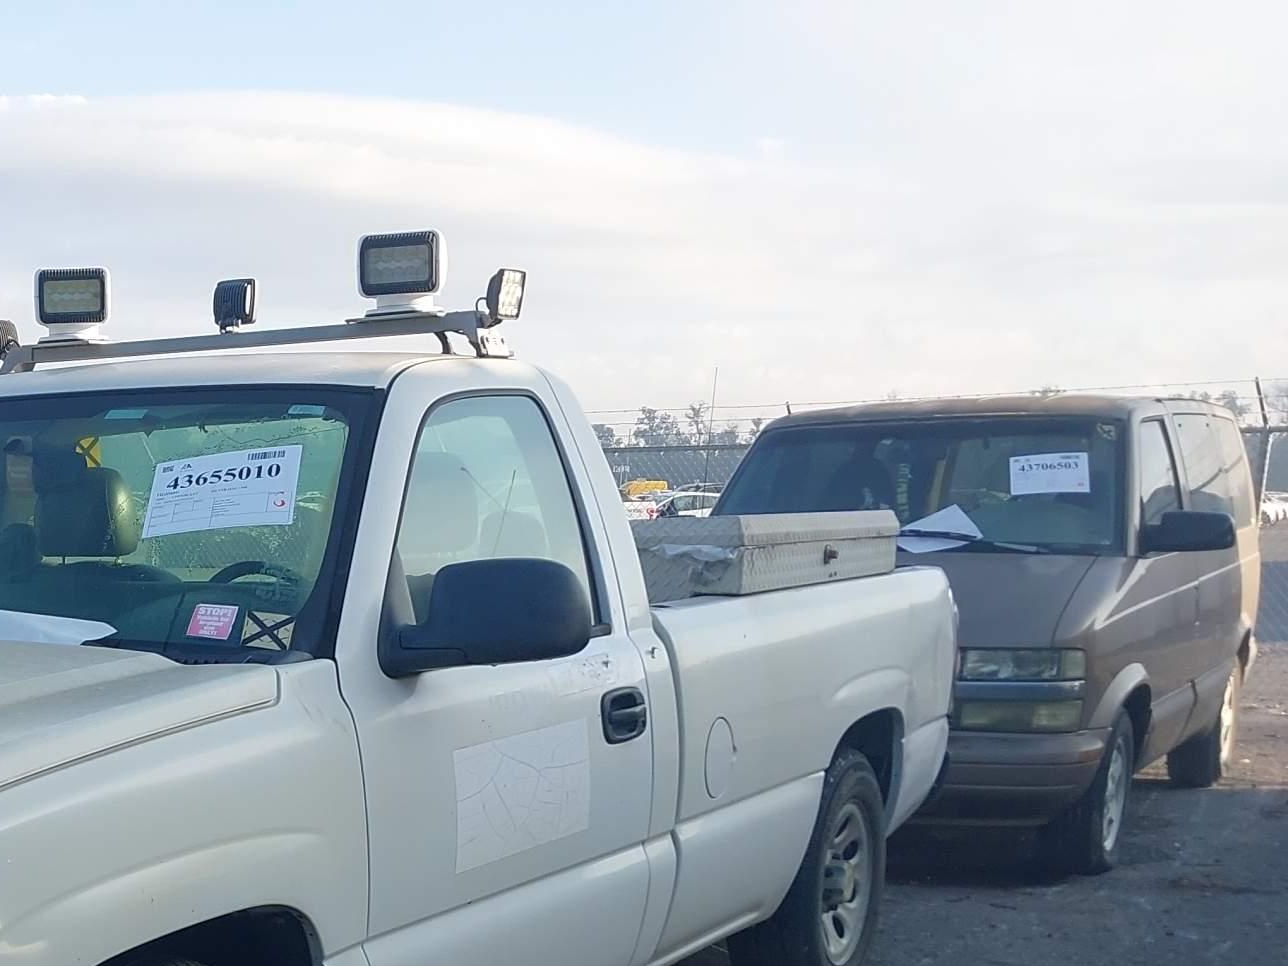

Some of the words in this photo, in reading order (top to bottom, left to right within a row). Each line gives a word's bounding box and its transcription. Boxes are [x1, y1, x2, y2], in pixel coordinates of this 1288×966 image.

[1018, 461, 1079, 472] 43706503
[166, 463, 281, 490] 43655010
[198, 607, 232, 616] STOP!
